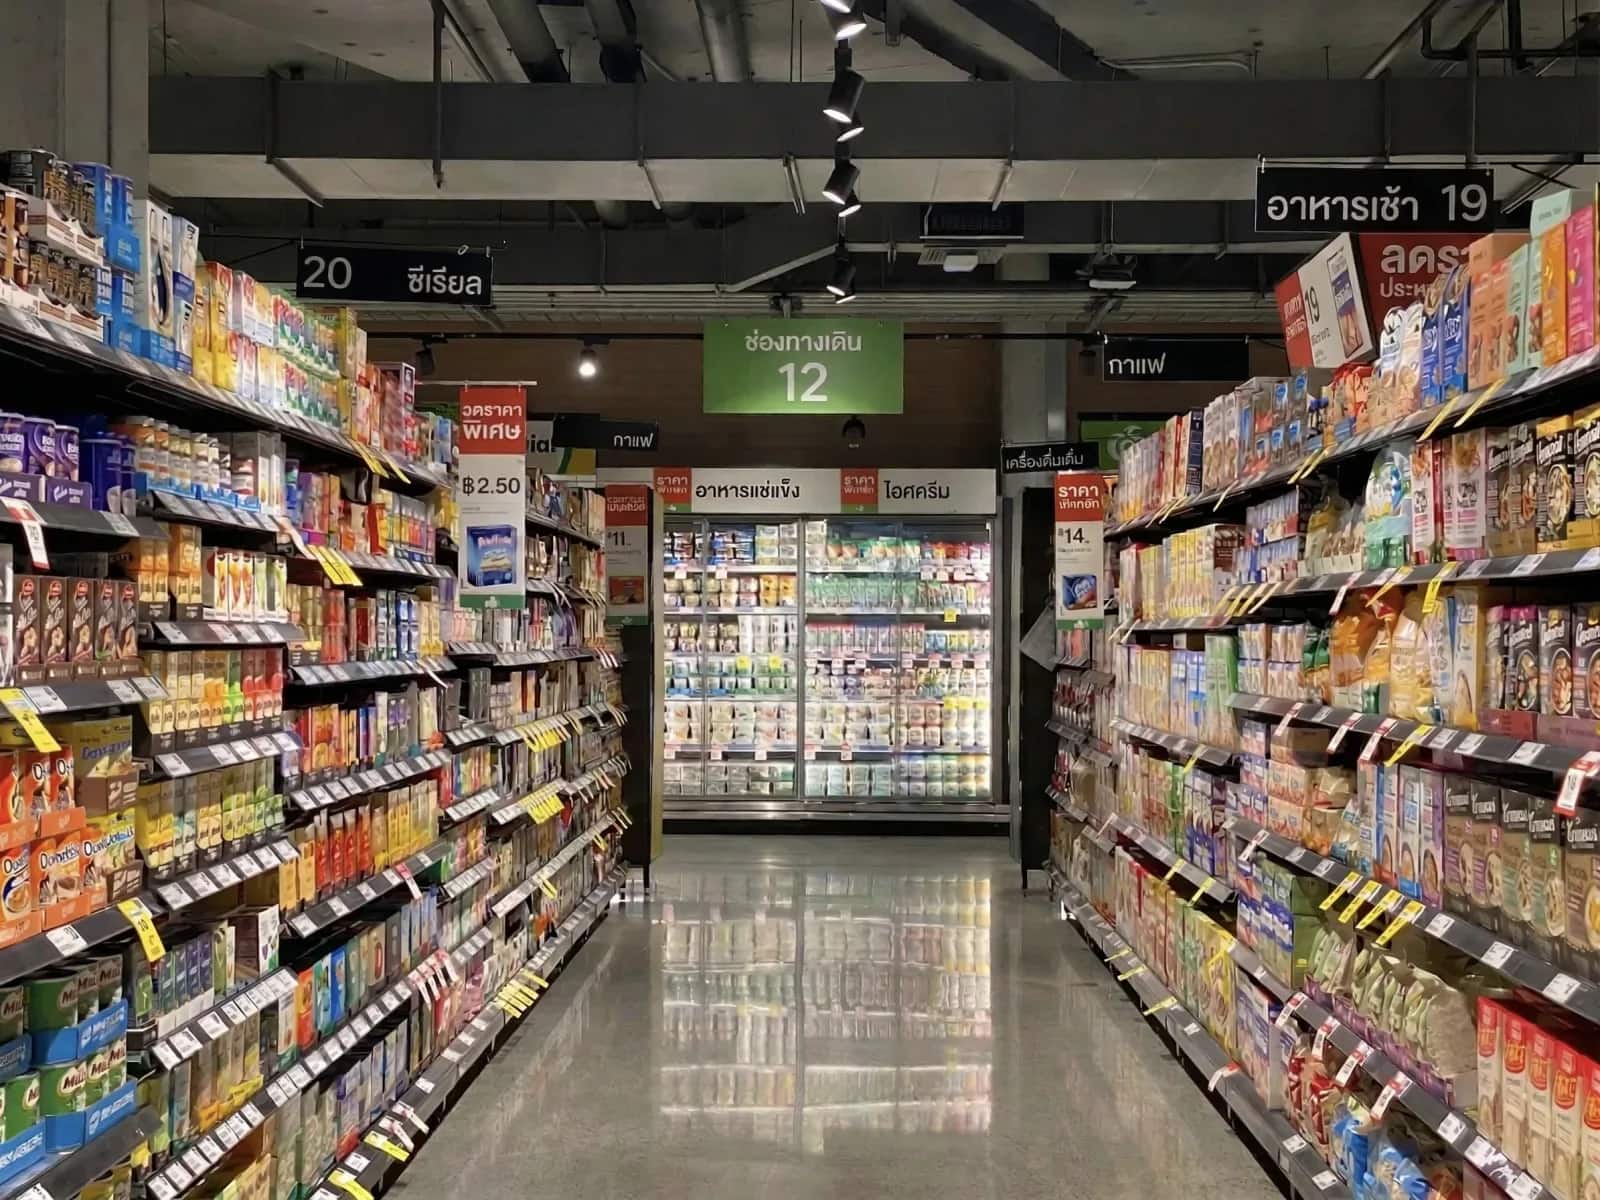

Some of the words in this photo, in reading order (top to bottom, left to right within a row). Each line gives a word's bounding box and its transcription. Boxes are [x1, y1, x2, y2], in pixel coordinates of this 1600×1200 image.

[1266, 185, 1418, 221] อาหารเช้า
[1441, 183, 1488, 221] 19
[303, 255, 352, 289] 20
[408, 264, 482, 295] ซีเรียล
[744, 328, 862, 352] ช่องทางเดิน
[1108, 351, 1166, 375] กาแฟ
[778, 362, 828, 402] 12
[462, 420, 522, 440] พิเศษ
[613, 432, 654, 448] กาแฟ
[695, 478, 800, 498] อาหารแช่แข็ง
[1058, 485, 1099, 497] ราคา
